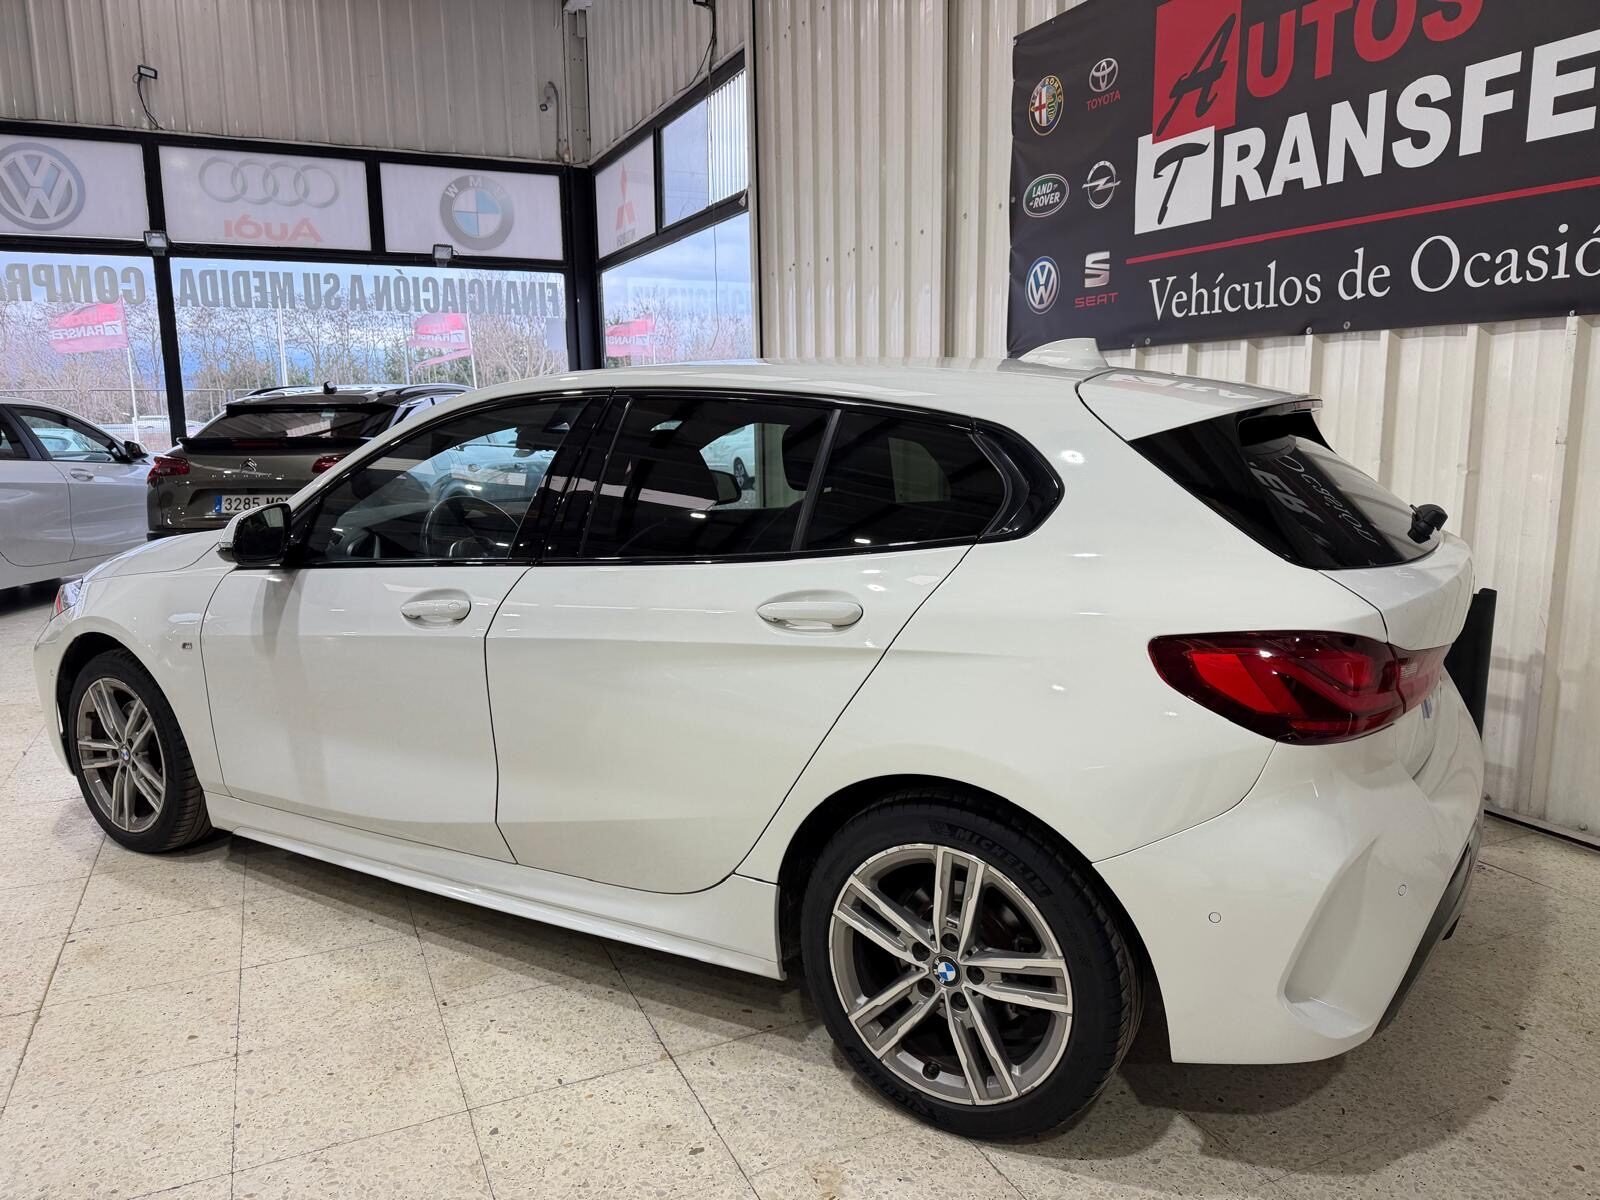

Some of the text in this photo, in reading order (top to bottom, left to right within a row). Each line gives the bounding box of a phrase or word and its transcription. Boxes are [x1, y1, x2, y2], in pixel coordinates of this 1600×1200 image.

[1086, 90, 1121, 111] TOYOTA
[1032, 182, 1053, 197] LAND
[1032, 191, 1061, 209] ROVER
[1149, 260, 1322, 321] Vehículos
[1337, 247, 1391, 301] de
[1074, 292, 1119, 308] SEAT
[224, 497, 261, 512] 3285
